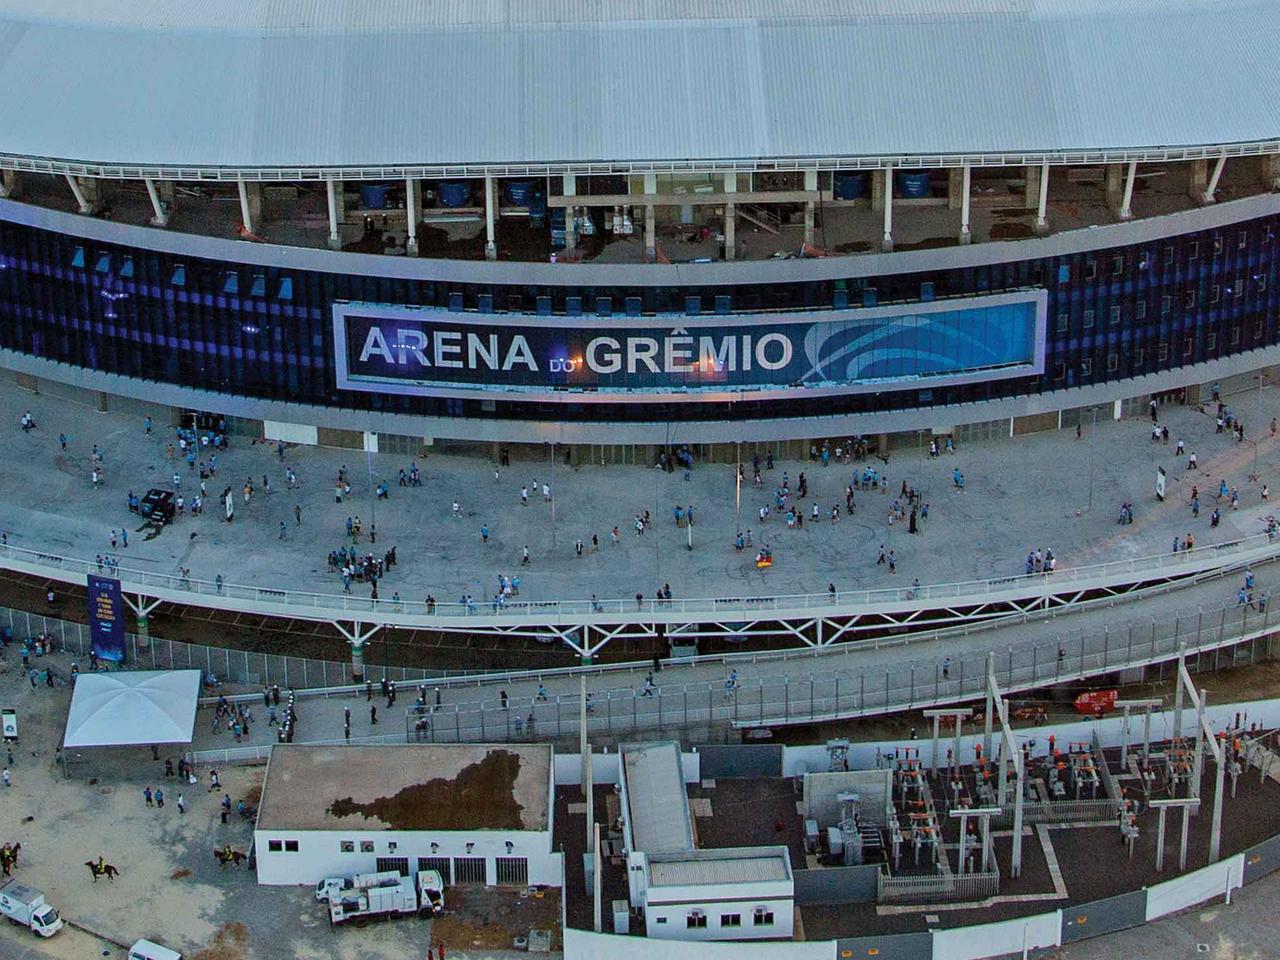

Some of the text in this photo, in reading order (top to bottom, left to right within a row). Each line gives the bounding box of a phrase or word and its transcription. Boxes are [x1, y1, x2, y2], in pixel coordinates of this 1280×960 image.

[359, 326, 793, 374] ARENA DO GRÊMIO
